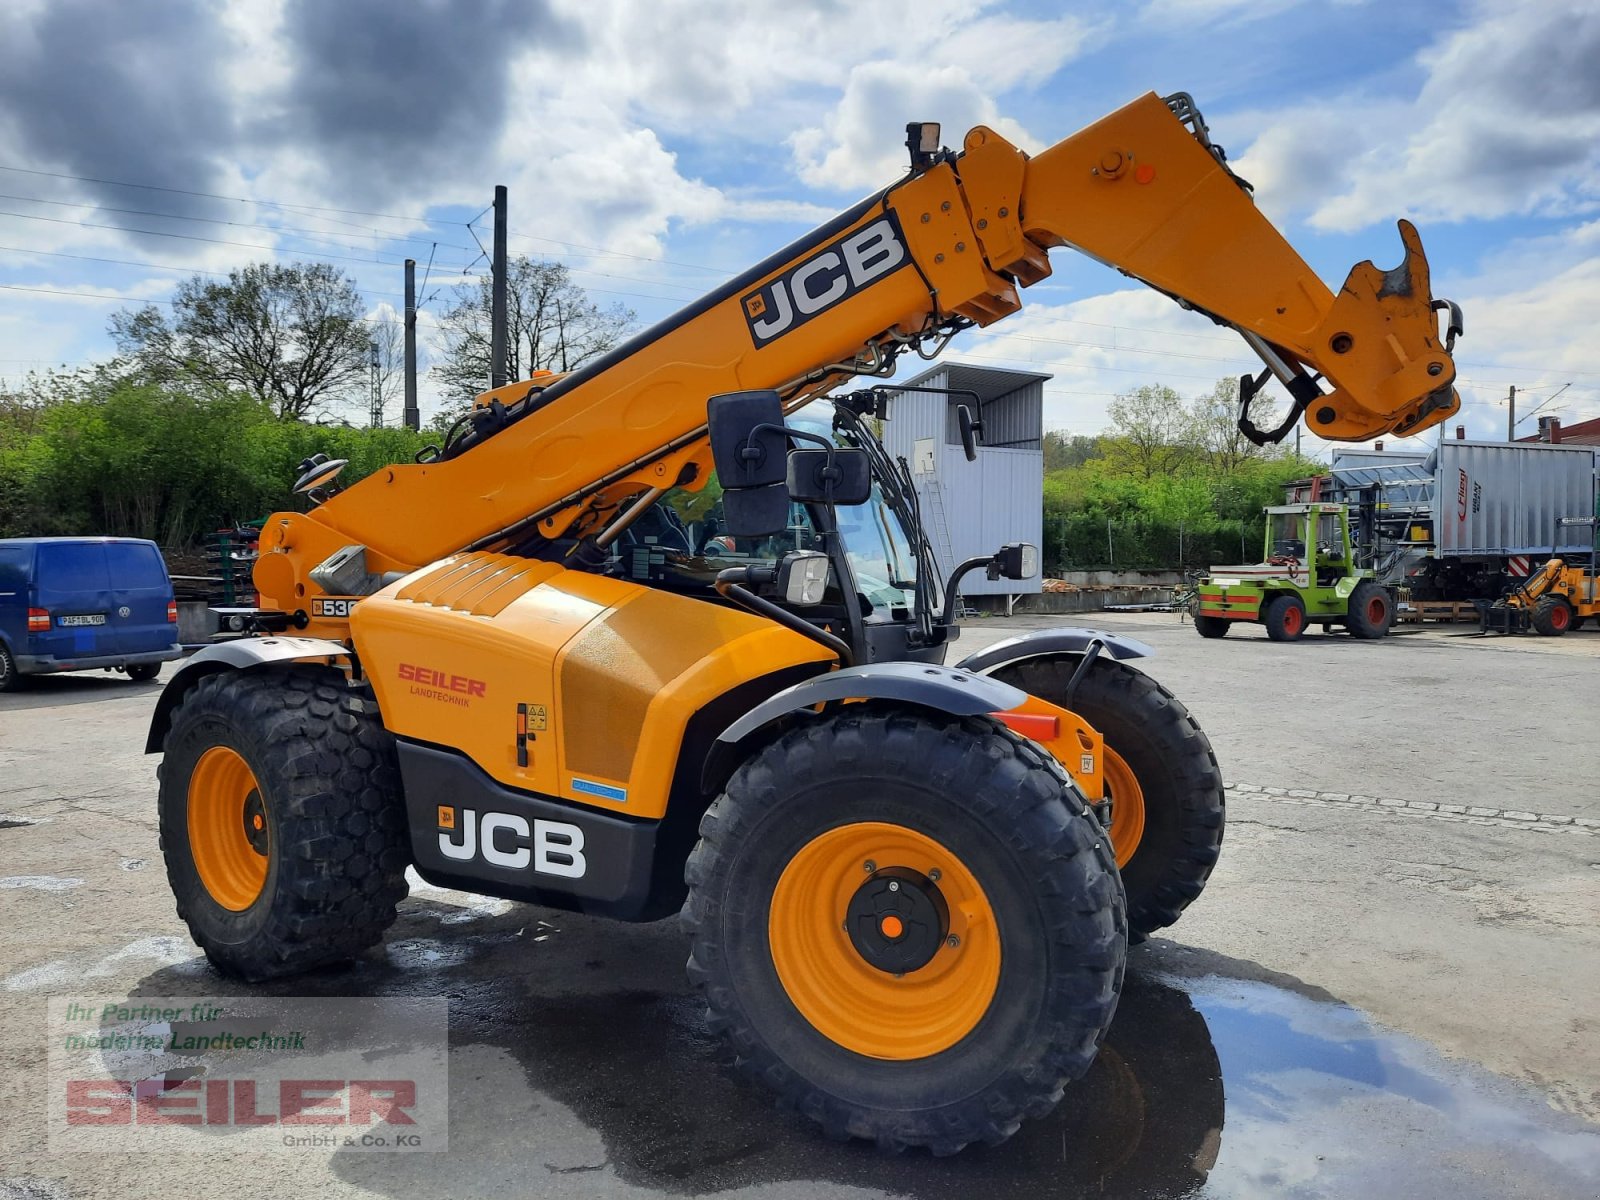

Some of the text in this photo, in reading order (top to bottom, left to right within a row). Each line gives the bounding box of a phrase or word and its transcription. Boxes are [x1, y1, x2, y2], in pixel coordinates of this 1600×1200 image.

[753, 219, 904, 340] JCB
[398, 663, 486, 698] SEILER
[410, 685, 470, 708] LANDTECHNIK
[438, 809, 587, 879] JCB
